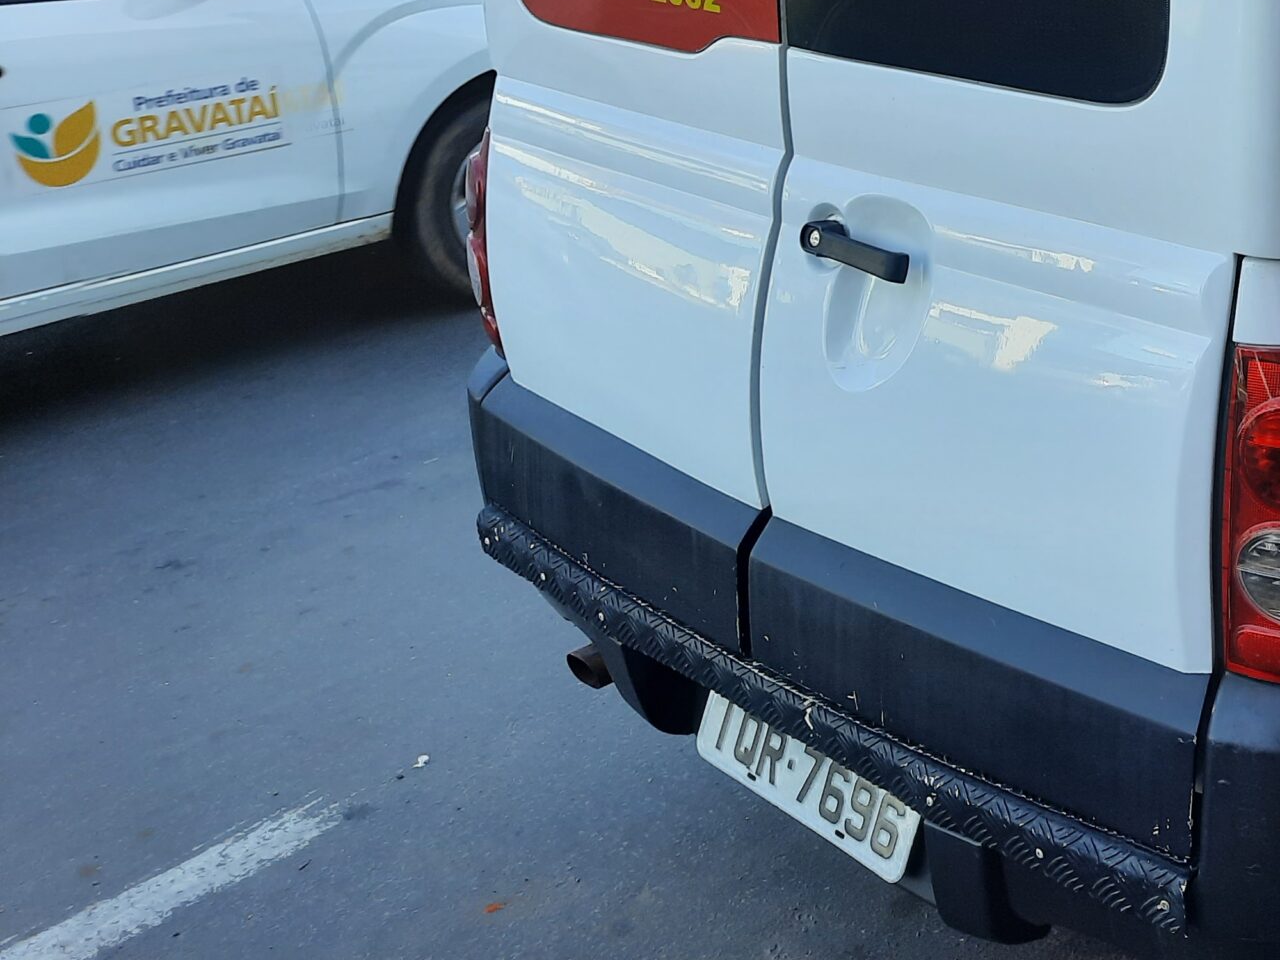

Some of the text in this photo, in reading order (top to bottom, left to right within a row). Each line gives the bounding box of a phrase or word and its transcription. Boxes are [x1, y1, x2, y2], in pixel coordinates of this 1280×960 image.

[111, 85, 281, 148] GRAVATAÍ
[132, 76, 260, 111] Prefeitura de
